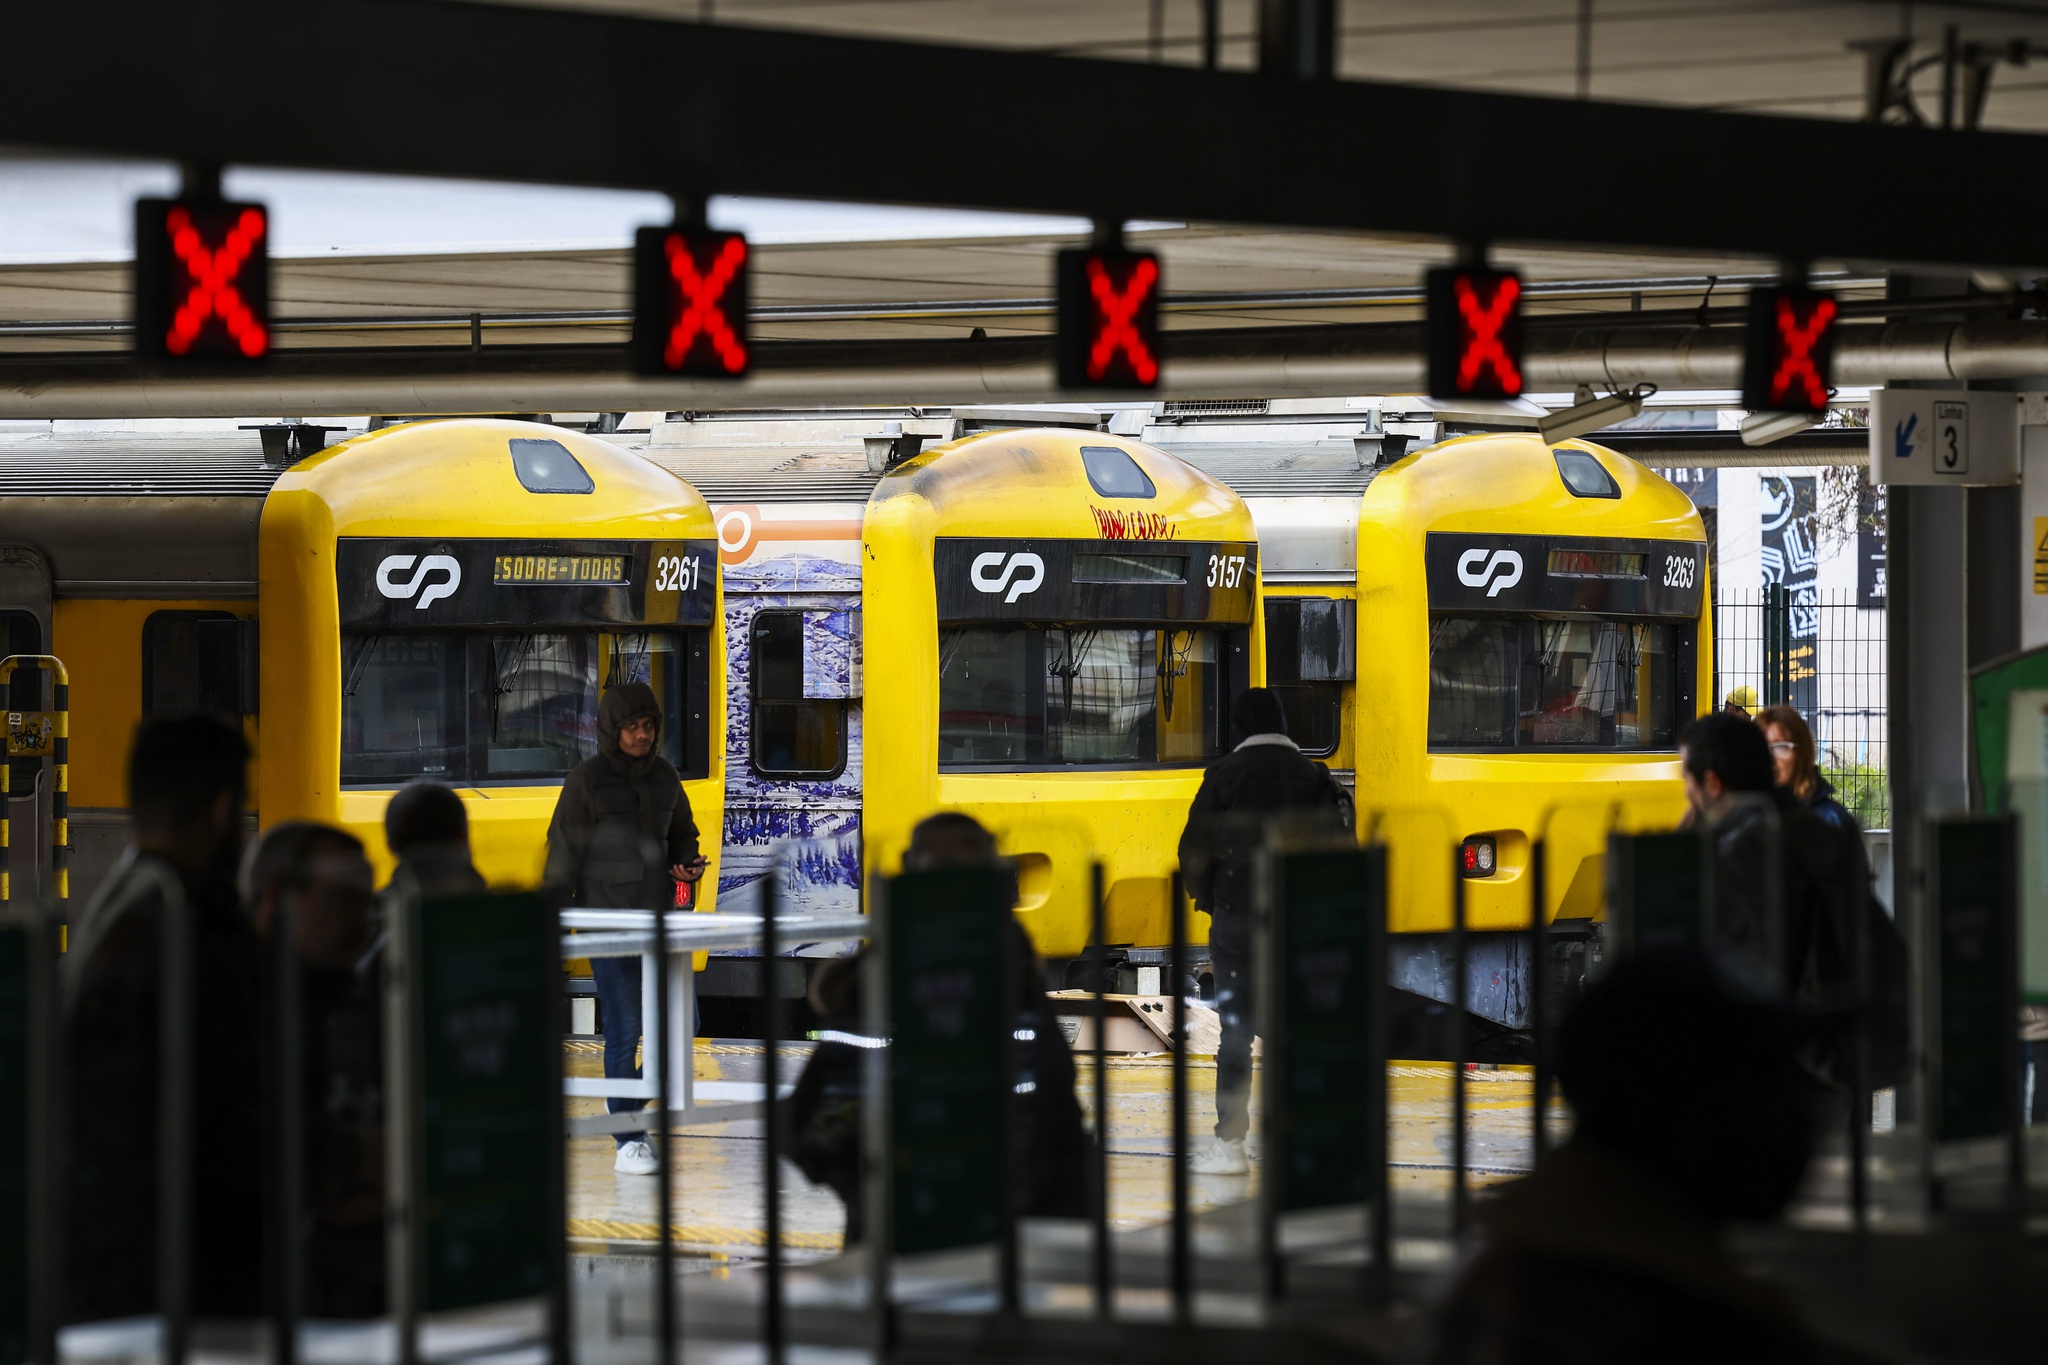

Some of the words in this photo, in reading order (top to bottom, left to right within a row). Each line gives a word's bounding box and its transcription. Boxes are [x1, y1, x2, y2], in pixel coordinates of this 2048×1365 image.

[1939, 405, 1963, 420] Linha
[1943, 426, 1958, 468] 3
[655, 556, 700, 591] 3261
[1206, 554, 1246, 588] 3157
[1663, 555, 1695, 589] 3263
